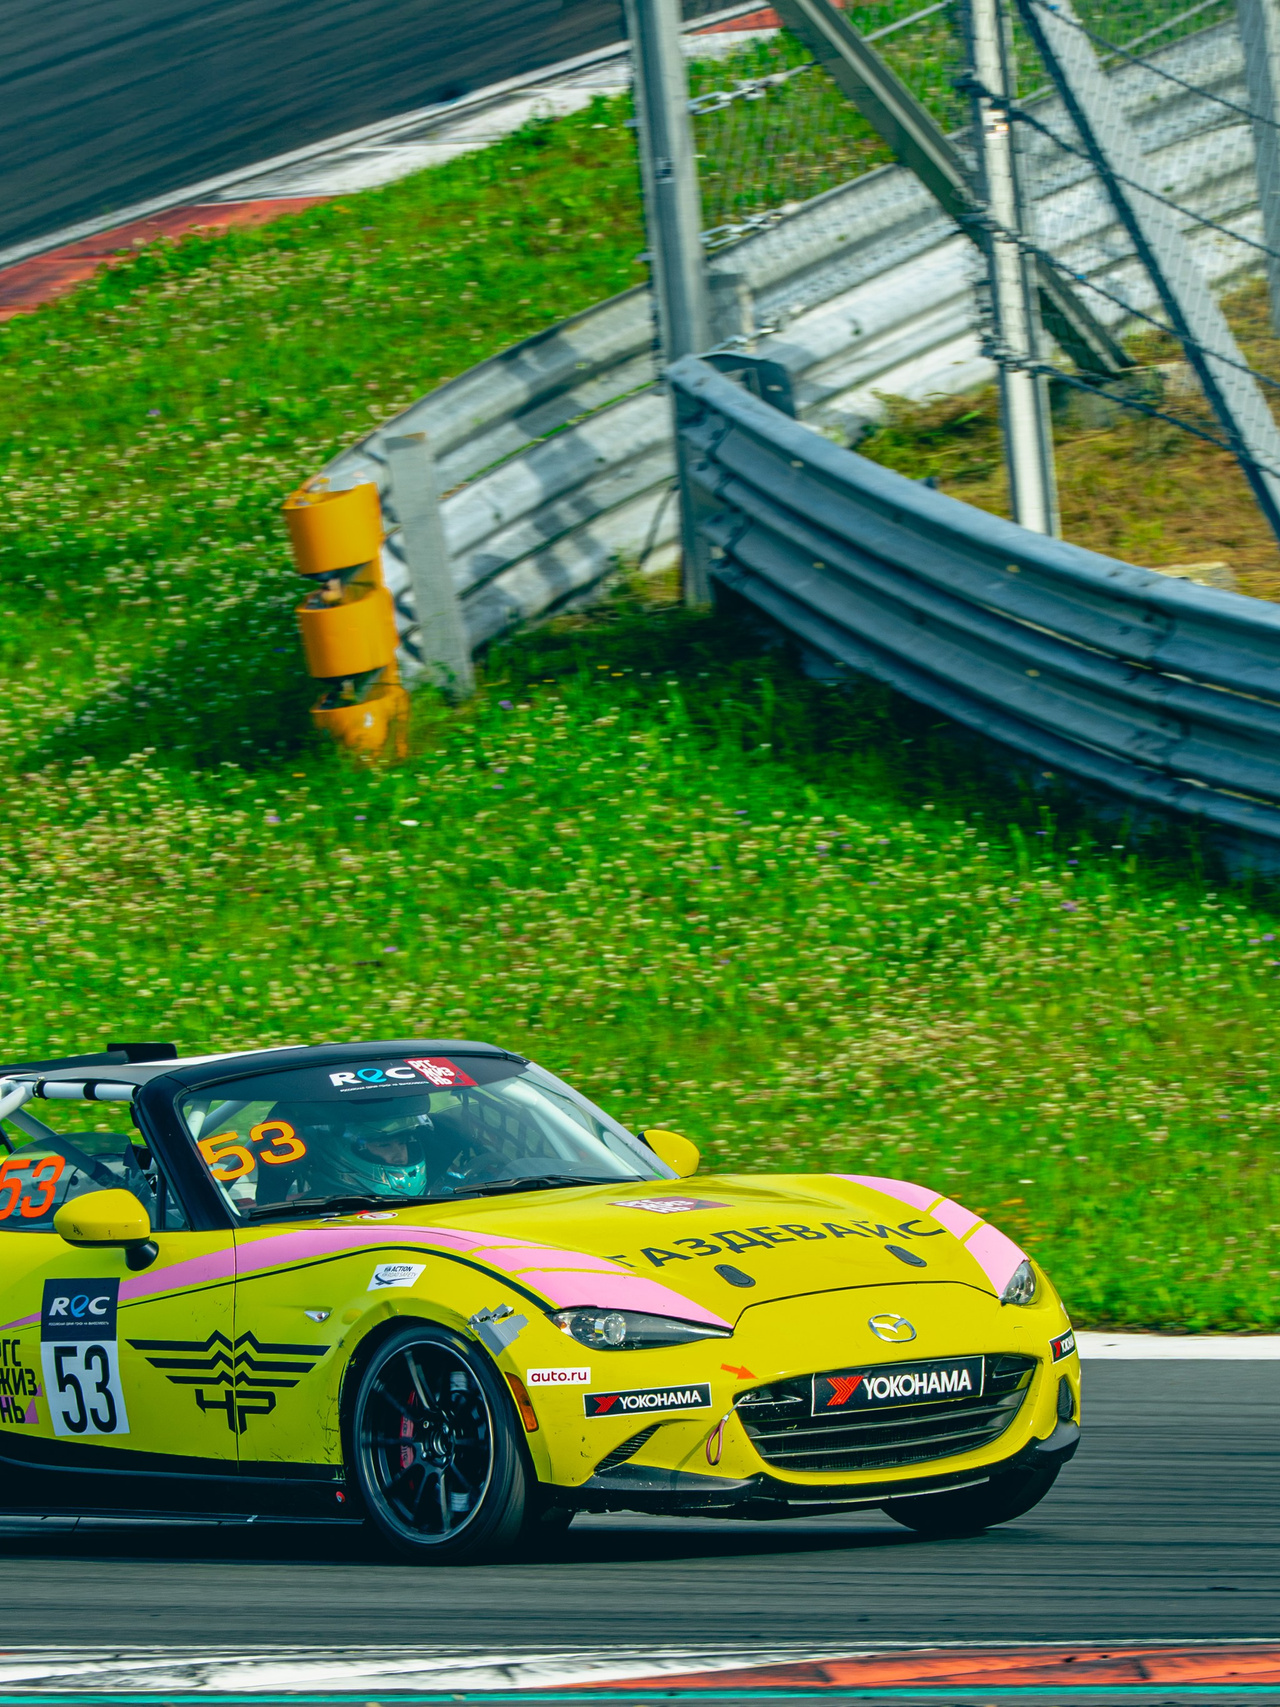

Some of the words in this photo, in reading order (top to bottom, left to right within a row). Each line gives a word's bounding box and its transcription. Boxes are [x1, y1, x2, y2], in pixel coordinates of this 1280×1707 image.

[197, 1121, 307, 1182] 53
[604, 1219, 947, 1268] ГАЗДЕВАЙС
[53, 1344, 118, 1434] 53
[531, 1370, 587, 1383] auto.ru
[862, 1369, 972, 1400] YOKOHAMA
[619, 1390, 703, 1410] YOKOHAMA
